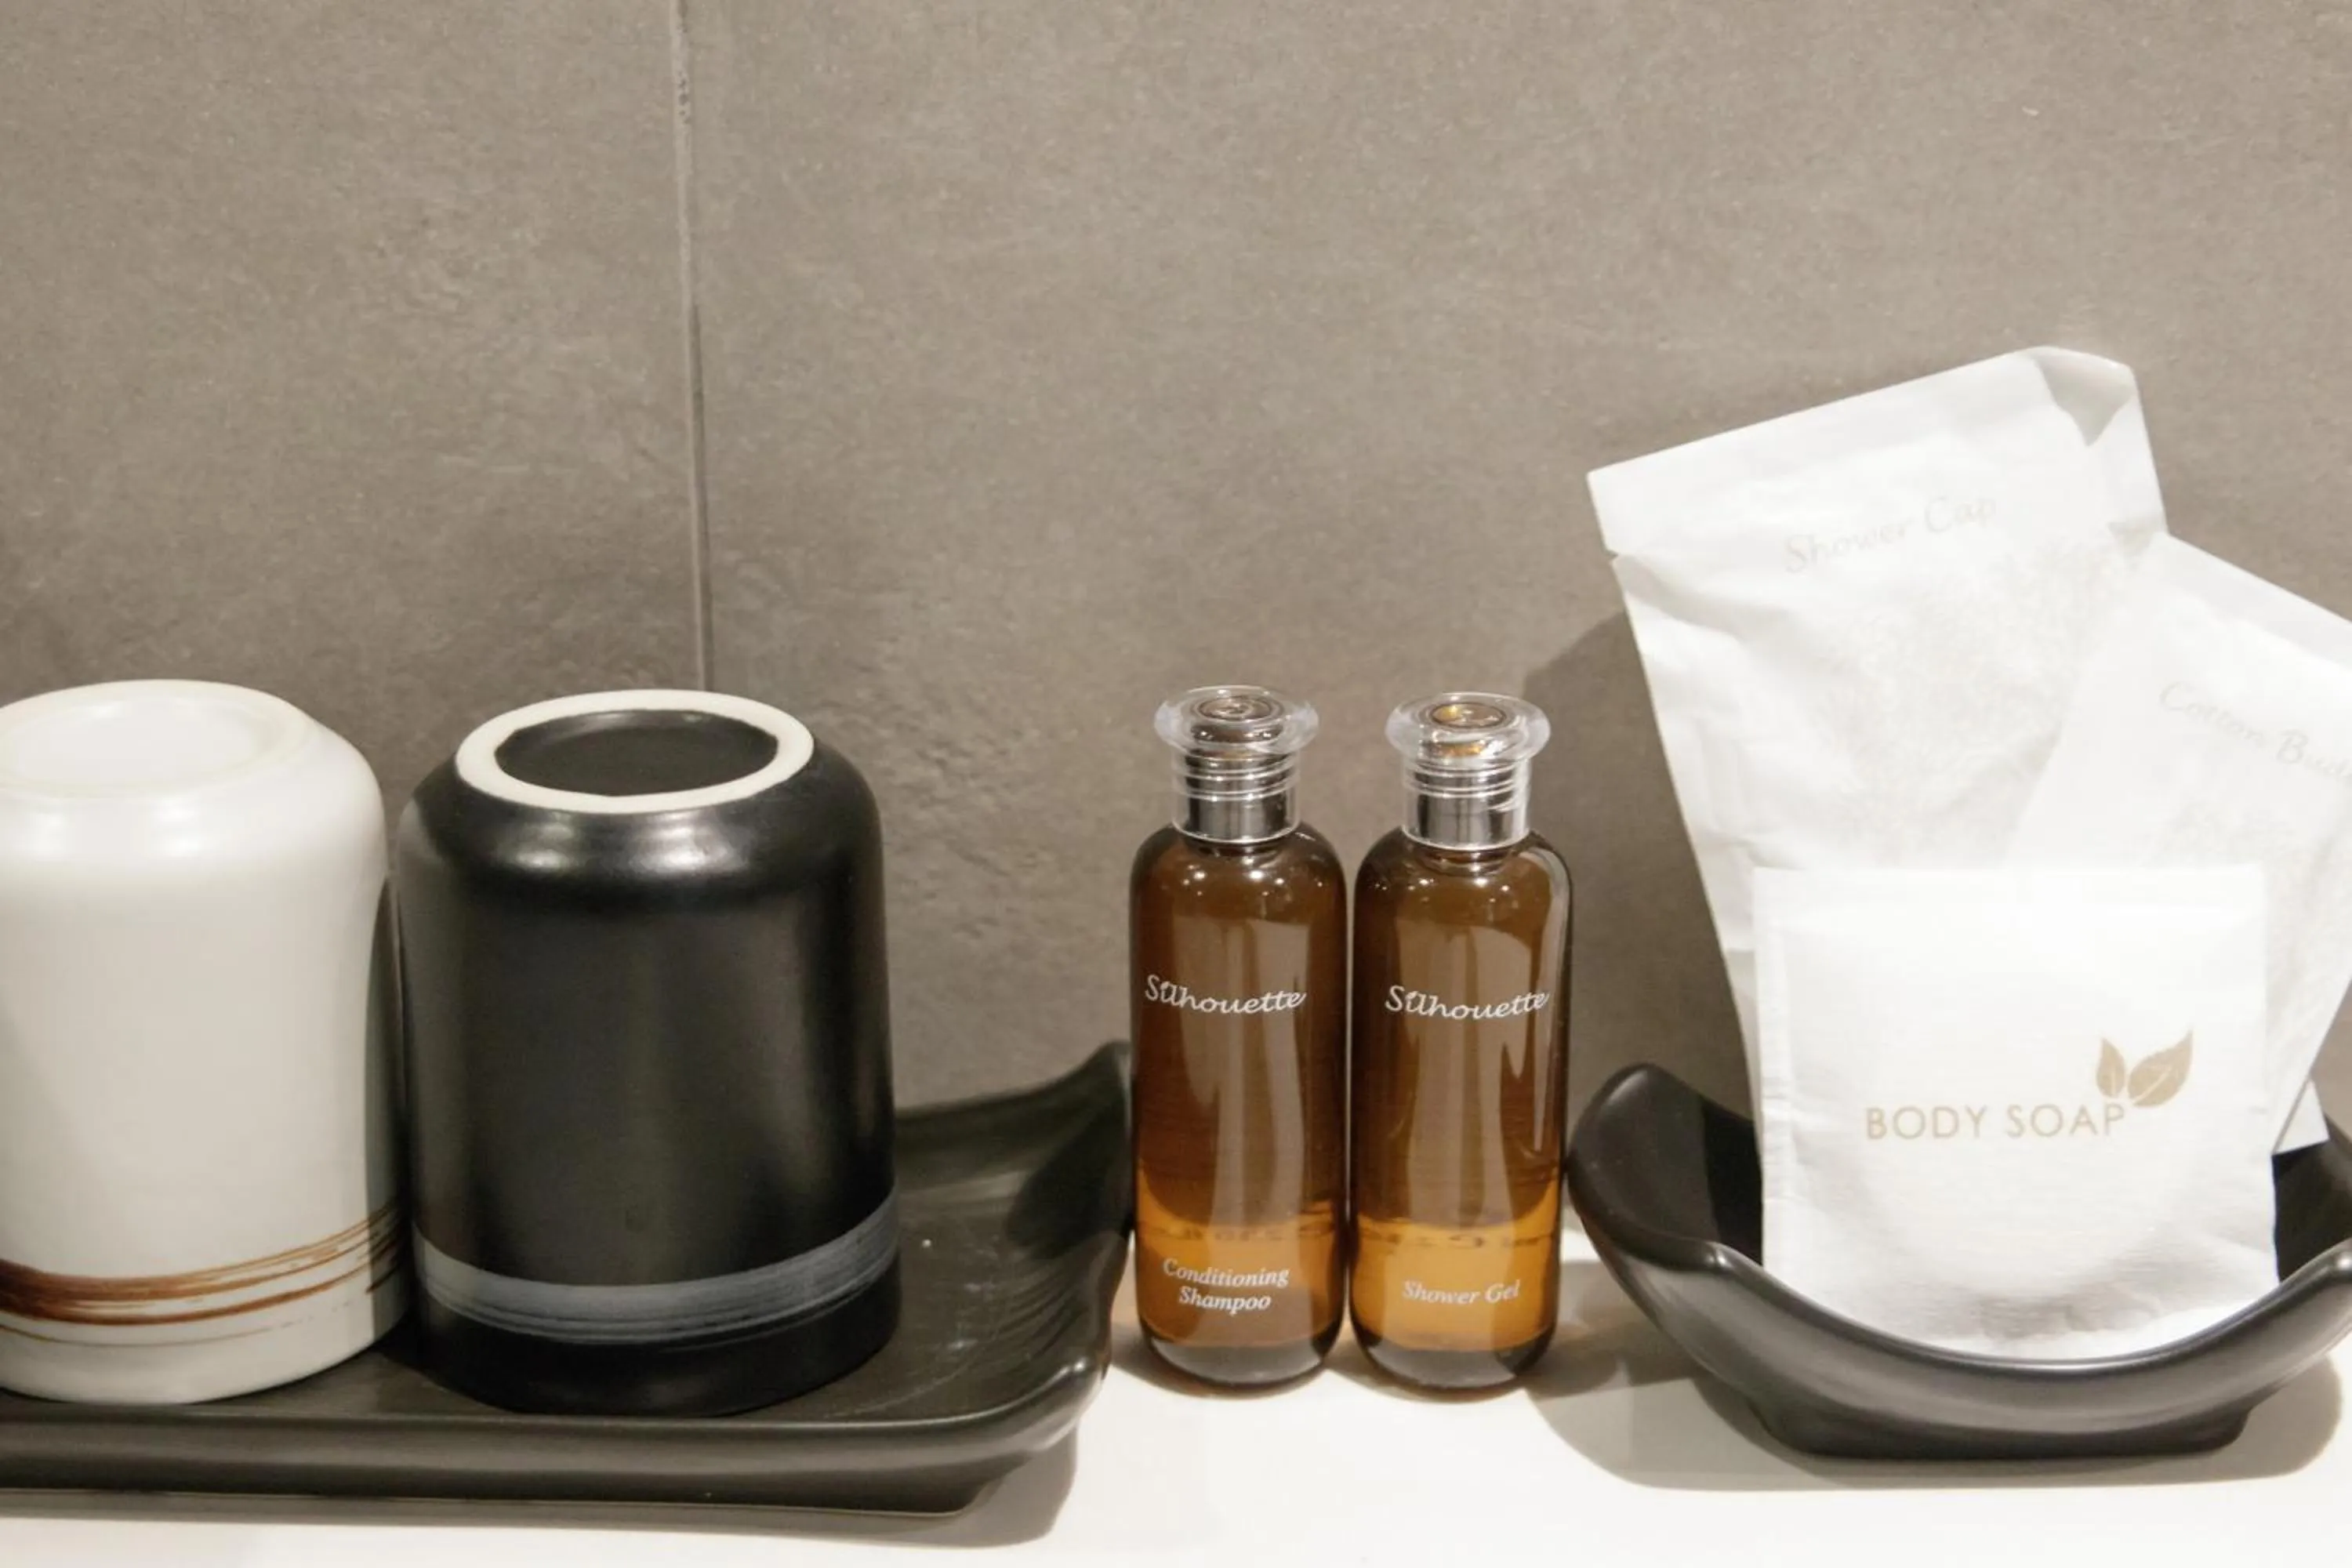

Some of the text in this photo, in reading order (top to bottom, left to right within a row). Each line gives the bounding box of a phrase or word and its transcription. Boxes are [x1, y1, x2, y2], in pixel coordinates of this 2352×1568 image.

[1784, 495, 1998, 574] Shower Cap
[1145, 975, 1306, 1014] Silhouette
[1385, 985, 1549, 1020] Silhouette
[1866, 1103, 2125, 1140] BODY SOAP
[1163, 1258, 1290, 1287] Conditioning
[1179, 1286, 1272, 1316] Shampoo
[1403, 1279, 1520, 1305] Shower Gel
